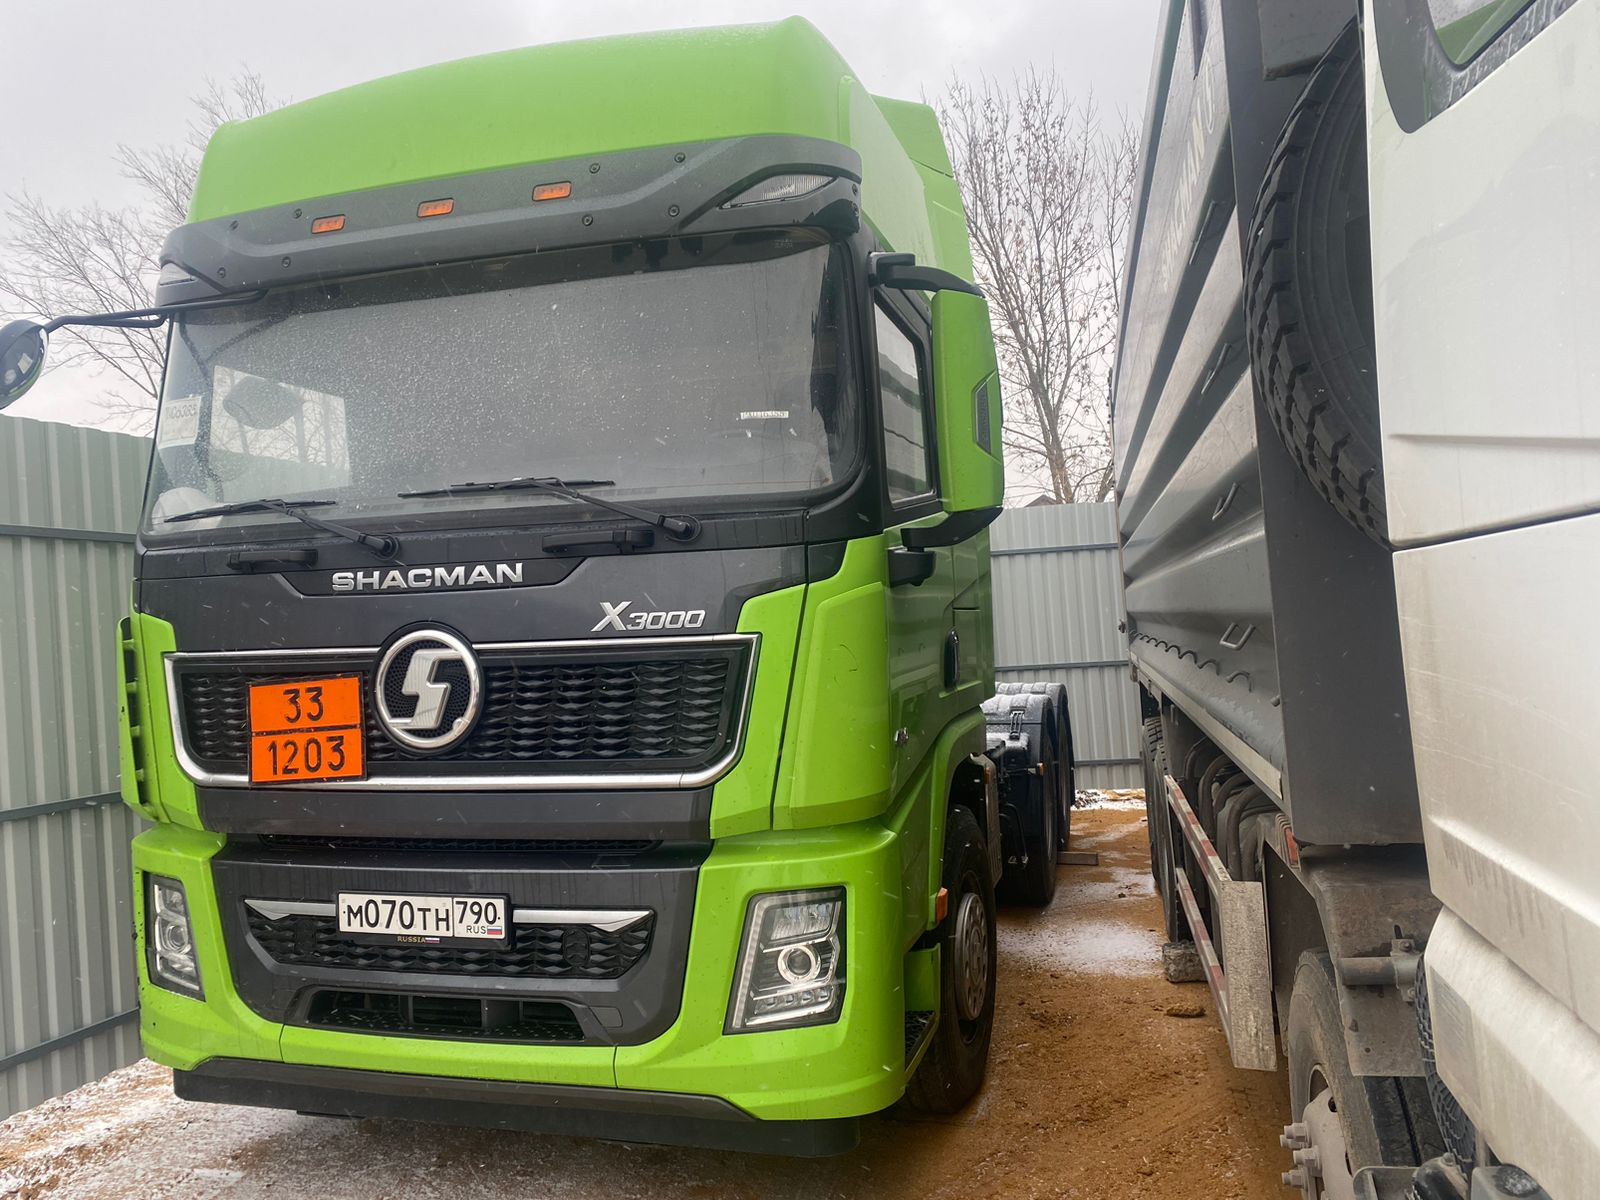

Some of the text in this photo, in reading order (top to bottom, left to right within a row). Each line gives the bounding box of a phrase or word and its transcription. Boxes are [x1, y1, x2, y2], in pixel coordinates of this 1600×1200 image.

[332, 563, 524, 591] SHACMAN
[592, 601, 706, 632] X3000
[283, 687, 324, 723] 33
[268, 736, 345, 776] 1203
[455, 900, 497, 925] 790
[466, 925, 487, 935] RUS
